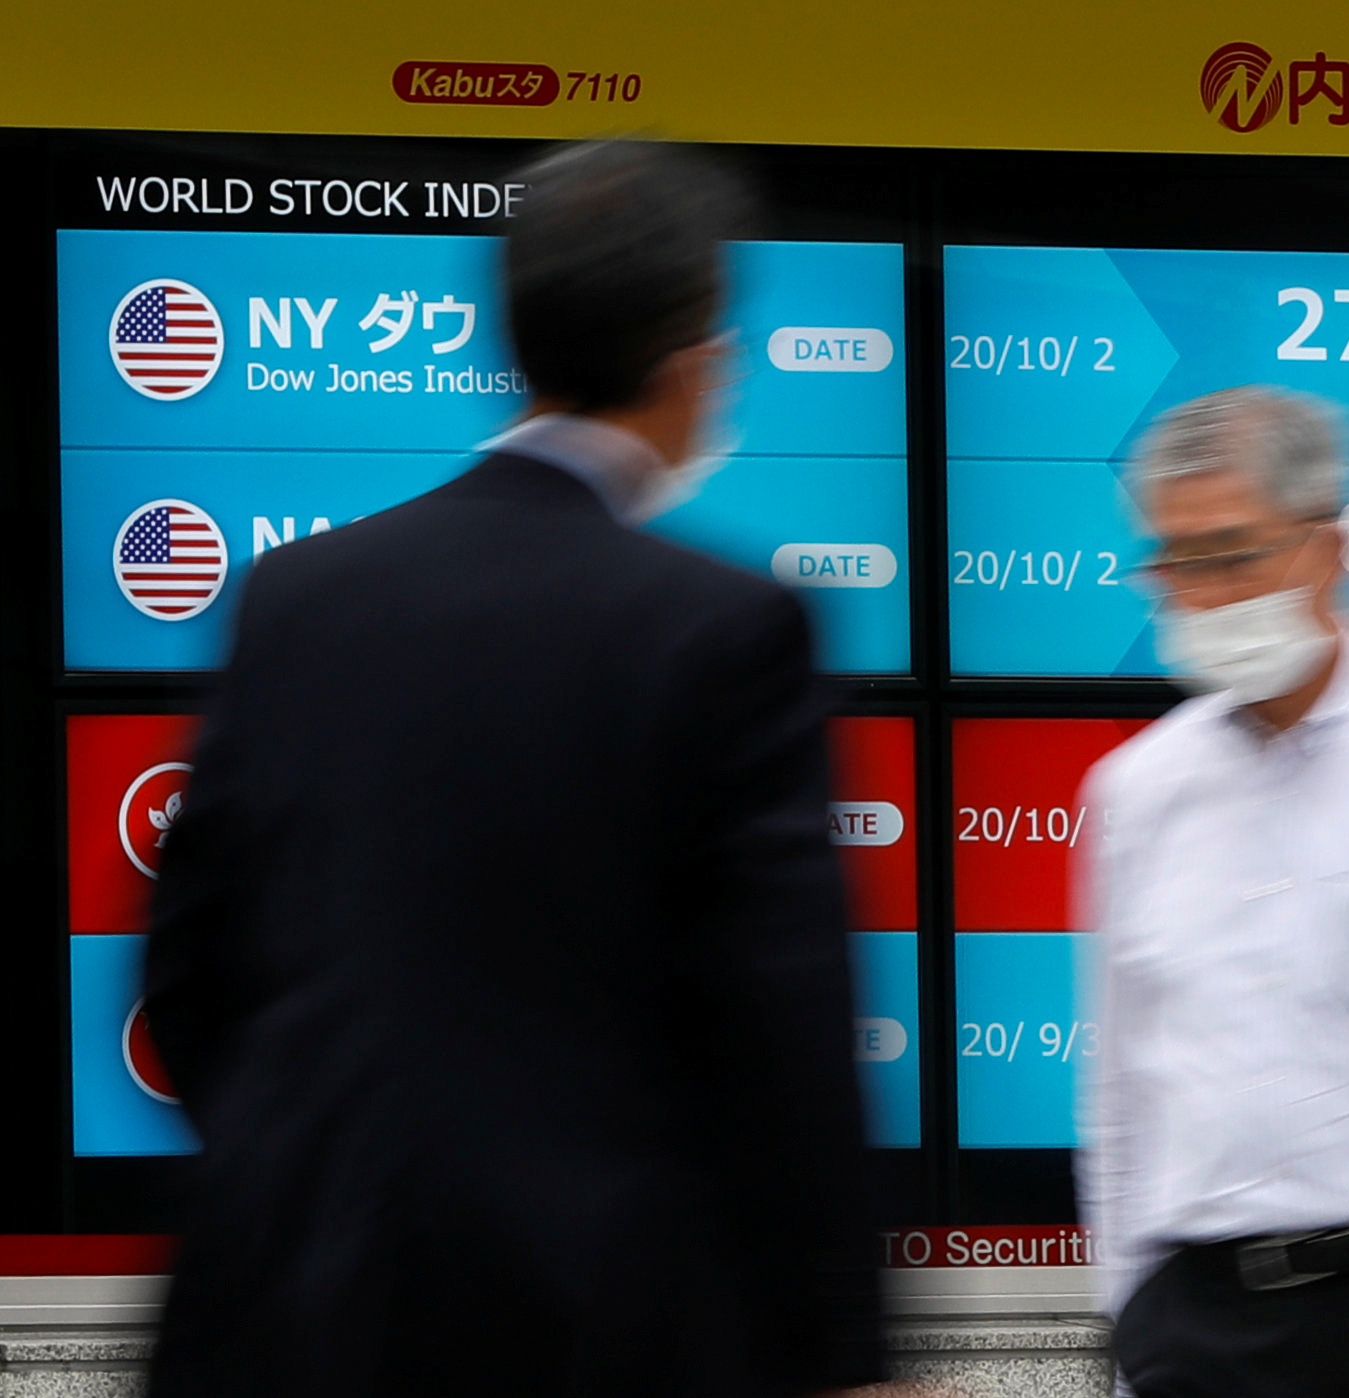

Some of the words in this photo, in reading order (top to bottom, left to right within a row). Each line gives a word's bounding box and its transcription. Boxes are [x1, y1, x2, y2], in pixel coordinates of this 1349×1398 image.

[409, 67, 545, 99] Kabuスタ
[566, 72, 641, 103] 7110
[97, 176, 254, 215] WORLD
[269, 179, 410, 218] STOCK
[424, 181, 533, 218] INDE
[249, 297, 338, 349] NY
[358, 290, 476, 354] ダウ
[795, 339, 867, 361] DATE
[247, 362, 315, 391] Dow
[326, 363, 413, 393] Jones
[800, 554, 872, 578] DATE
[827, 812, 878, 835] ATE
